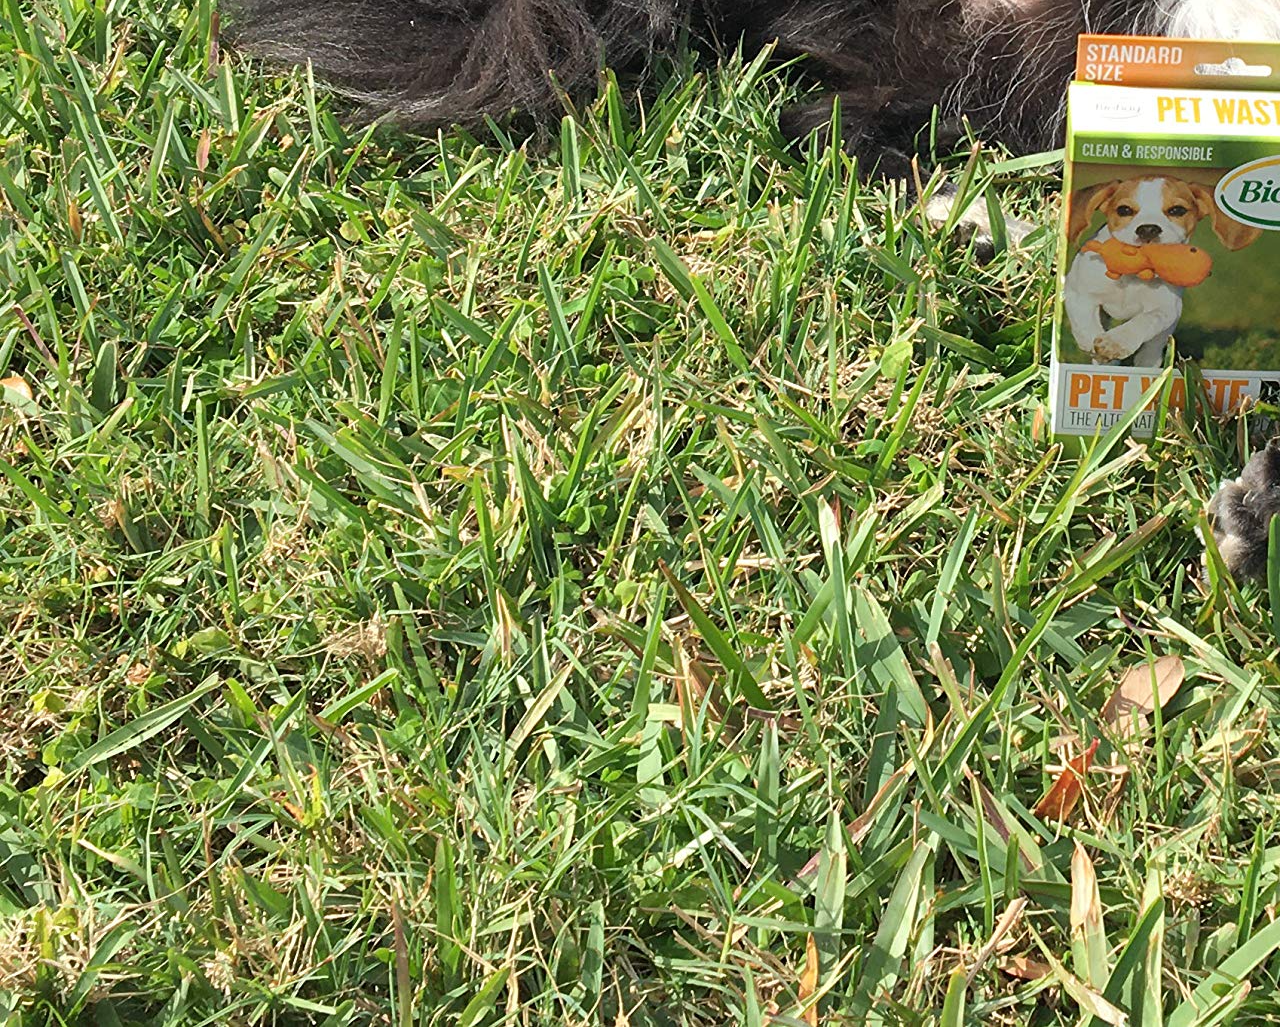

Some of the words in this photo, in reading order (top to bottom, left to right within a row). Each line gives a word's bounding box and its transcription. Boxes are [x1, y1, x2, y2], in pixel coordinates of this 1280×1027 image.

[1086, 43, 1184, 65] STANDARD
[1085, 63, 1124, 82] SIZE
[1157, 96, 1202, 124] PET
[1082, 143, 1119, 159] CLEAN
[1121, 145, 1132, 159] &
[1135, 145, 1214, 162] RESPONSIBLE
[1069, 373, 1129, 410] PET
[1070, 411, 1091, 426] THE
